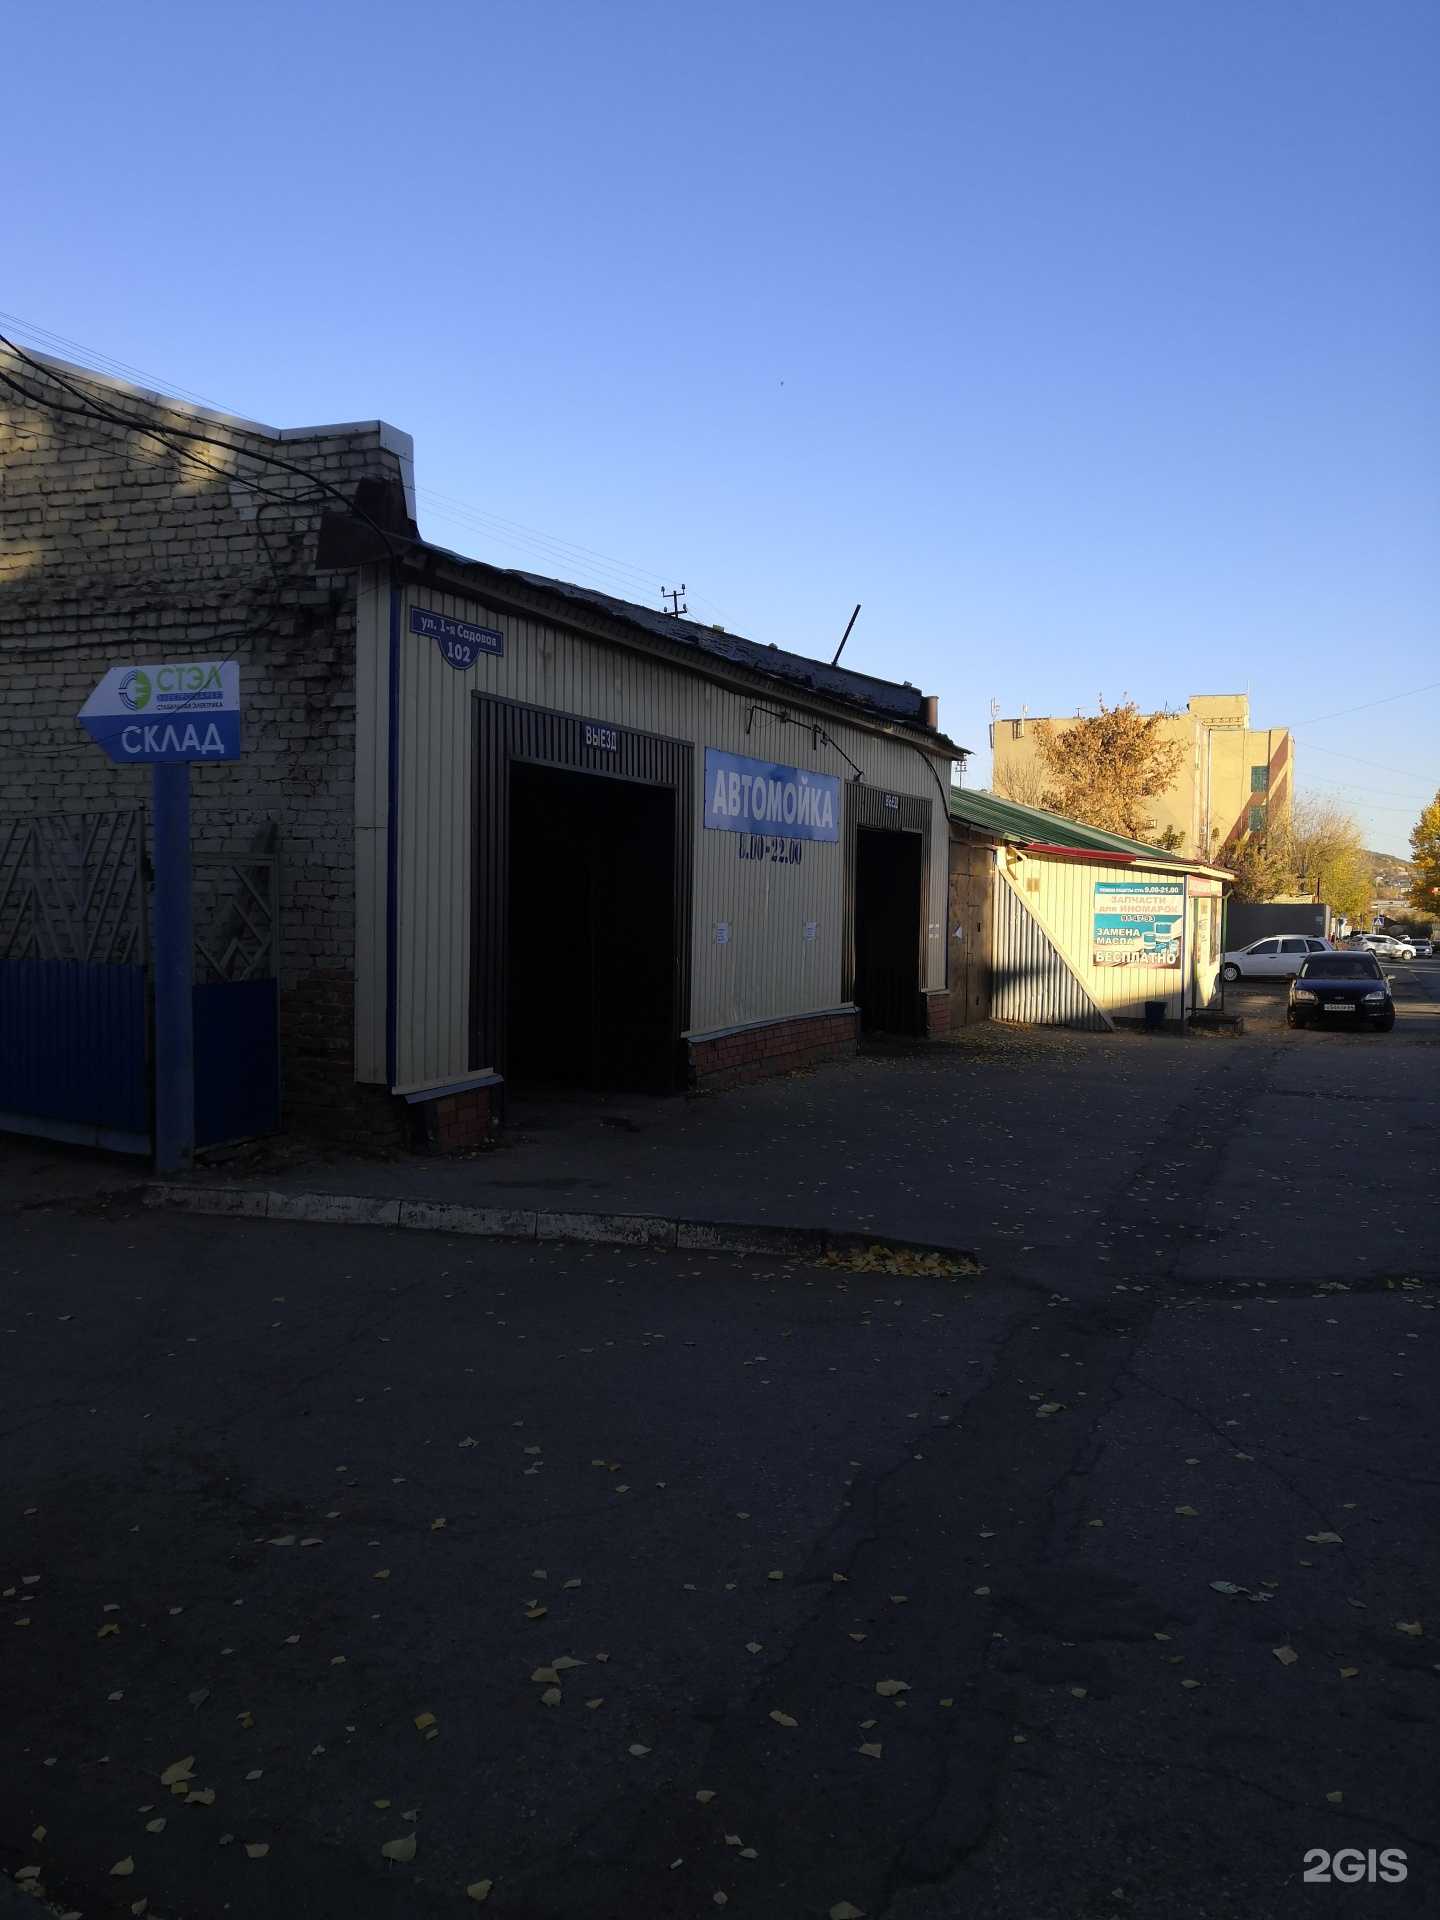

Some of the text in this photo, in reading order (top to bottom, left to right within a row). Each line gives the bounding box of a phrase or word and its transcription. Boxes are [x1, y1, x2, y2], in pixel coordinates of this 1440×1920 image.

[421, 617, 497, 647] ул. 1-я Садовая
[447, 642, 471, 662] 102
[156, 666, 223, 691] СТЭЛ
[121, 723, 225, 754] СКЛАД
[585, 725, 617, 752] ВЫЕЗД
[712, 769, 833, 829] АВТОМОЙКА
[1145, 886, 1179, 894] 9.00-21.00
[1111, 896, 1166, 904] ЗАПЧАСТИ
[1120, 905, 1178, 913] ИНОМАРОК
[1095, 927, 1140, 937] ЗАМЕНА
[1096, 937, 1135, 945] МАСЛА
[1095, 951, 1177, 965] БЕСПЛАТНО
